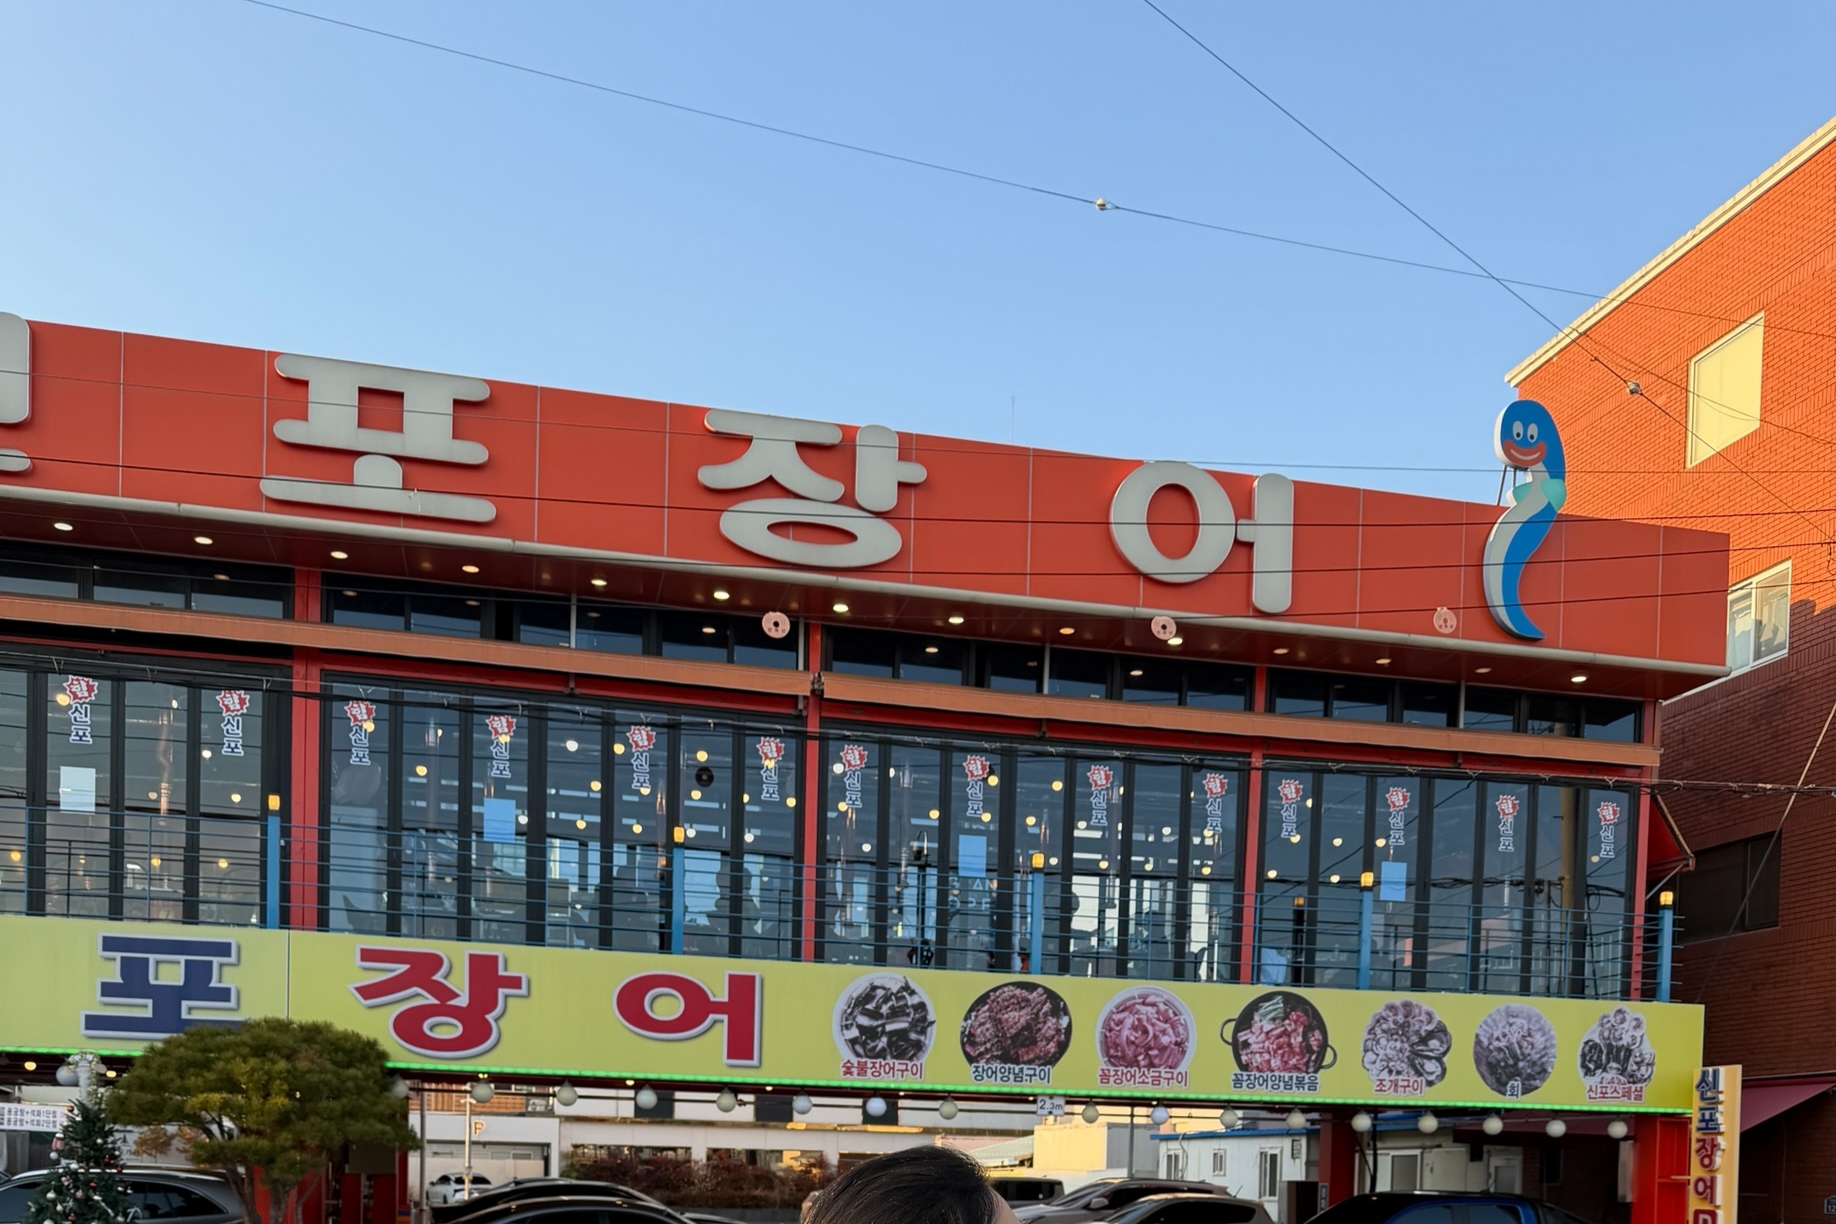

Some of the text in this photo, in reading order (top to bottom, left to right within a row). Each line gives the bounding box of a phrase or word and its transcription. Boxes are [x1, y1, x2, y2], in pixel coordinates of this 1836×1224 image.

[68, 704, 92, 744] 신포
[220, 716, 244, 756] 신포
[349, 726, 371, 765] 신포
[490, 738, 511, 778] 신포
[631, 752, 650, 790] 신포
[761, 764, 780, 801] 신포
[844, 772, 863, 808] 신포
[966, 780, 984, 817] 신포
[1090, 789, 1107, 826] 신포
[1206, 797, 1222, 833] 신포
[1280, 803, 1297, 838] 신포
[1388, 811, 1405, 846] 신포
[1498, 818, 1514, 852] 신포
[1600, 825, 1615, 858] 신포
[841, 1059, 924, 1080] 숯불장어구이
[971, 1064, 1051, 1084] 장어양념구이
[1098, 1067, 1188, 1087] 꼼장어소금구이
[1231, 1072, 1319, 1092] 꼼장어양념볶음
[1374, 1078, 1425, 1096] 조개구이
[1039, 1098, 1064, 1111] 2.3m
[1506, 1081, 1521, 1099] 회
[1586, 1084, 1644, 1102] 신포스페셜
[472, 1119, 486, 1136] P
[1693, 1067, 1722, 1206] 신포장어
